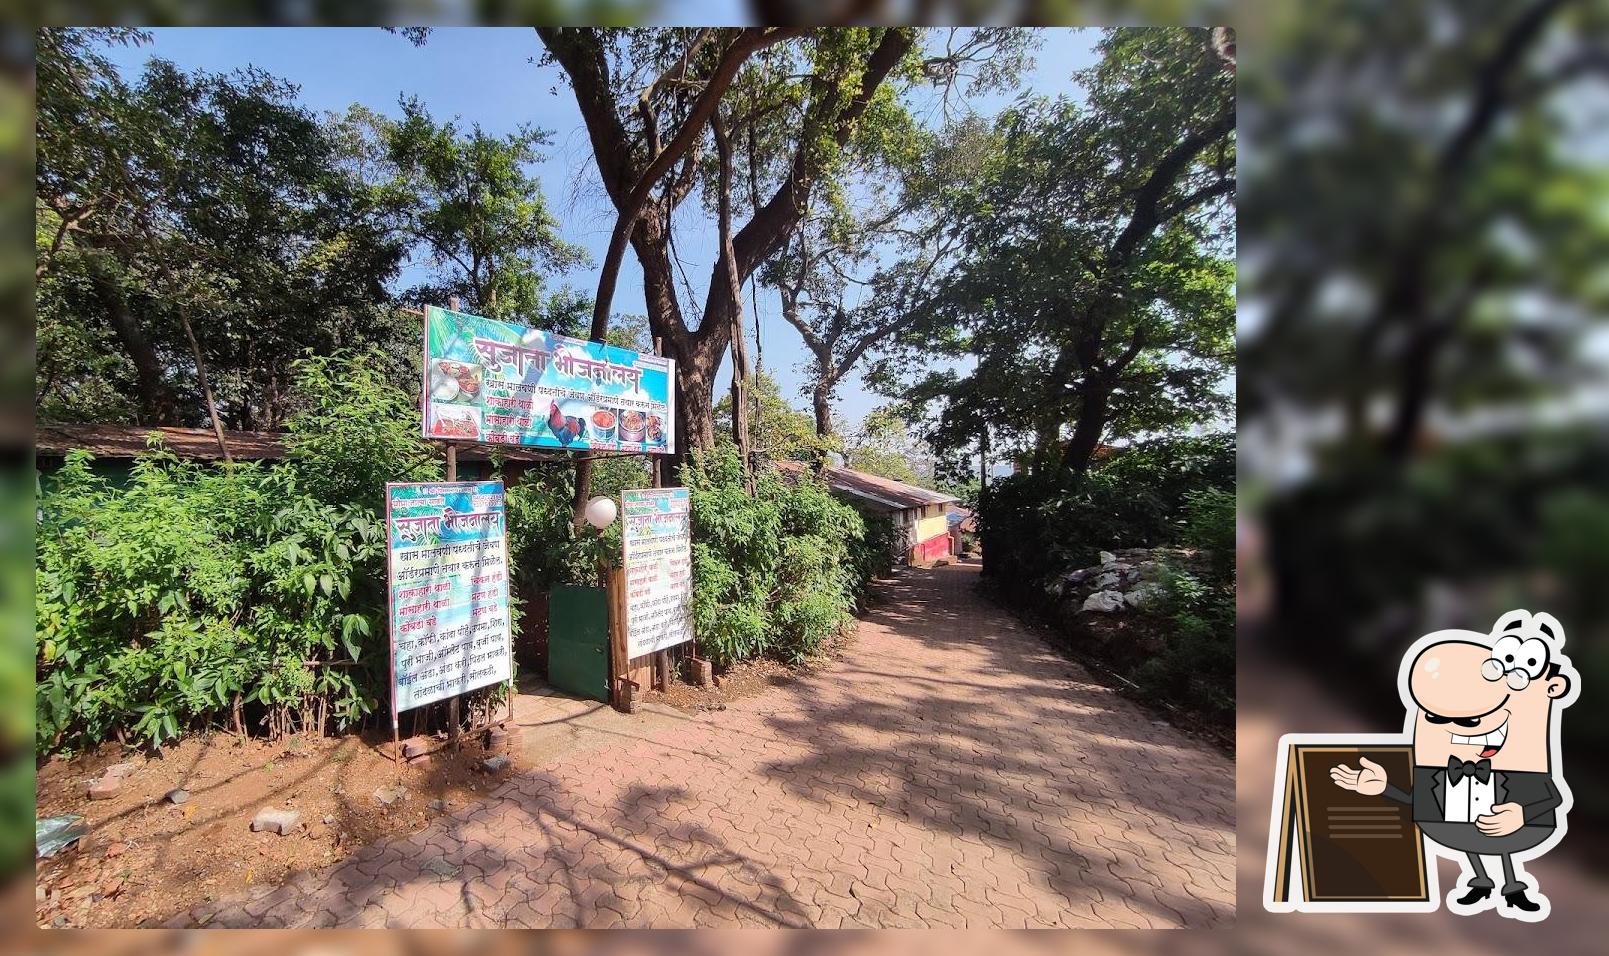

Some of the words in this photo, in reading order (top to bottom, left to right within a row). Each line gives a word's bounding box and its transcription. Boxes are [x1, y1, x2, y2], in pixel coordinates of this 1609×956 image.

[443, 507, 502, 530] भोजनालय
[400, 550, 419, 562] खास
[441, 562, 460, 574] तयार
